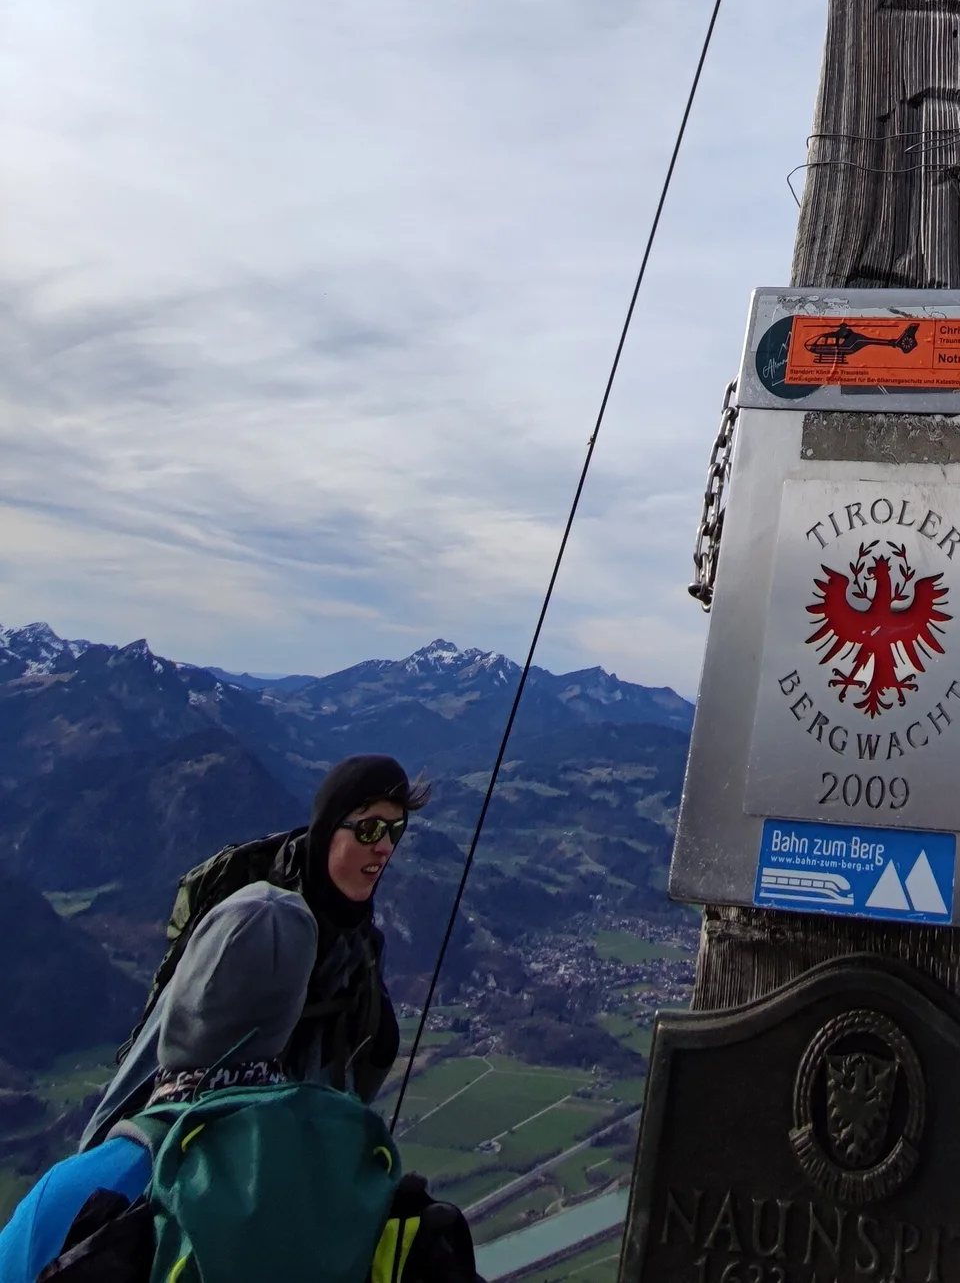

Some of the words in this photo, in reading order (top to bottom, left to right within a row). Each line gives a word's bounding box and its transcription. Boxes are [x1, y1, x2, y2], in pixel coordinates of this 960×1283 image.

[818, 772, 910, 810] 2009
[770, 855, 875, 872] www.bahn-zum-berg.at
[771, 829, 808, 855] Bahn
[813, 837, 847, 857] zum
[851, 836, 884, 866] Berg
